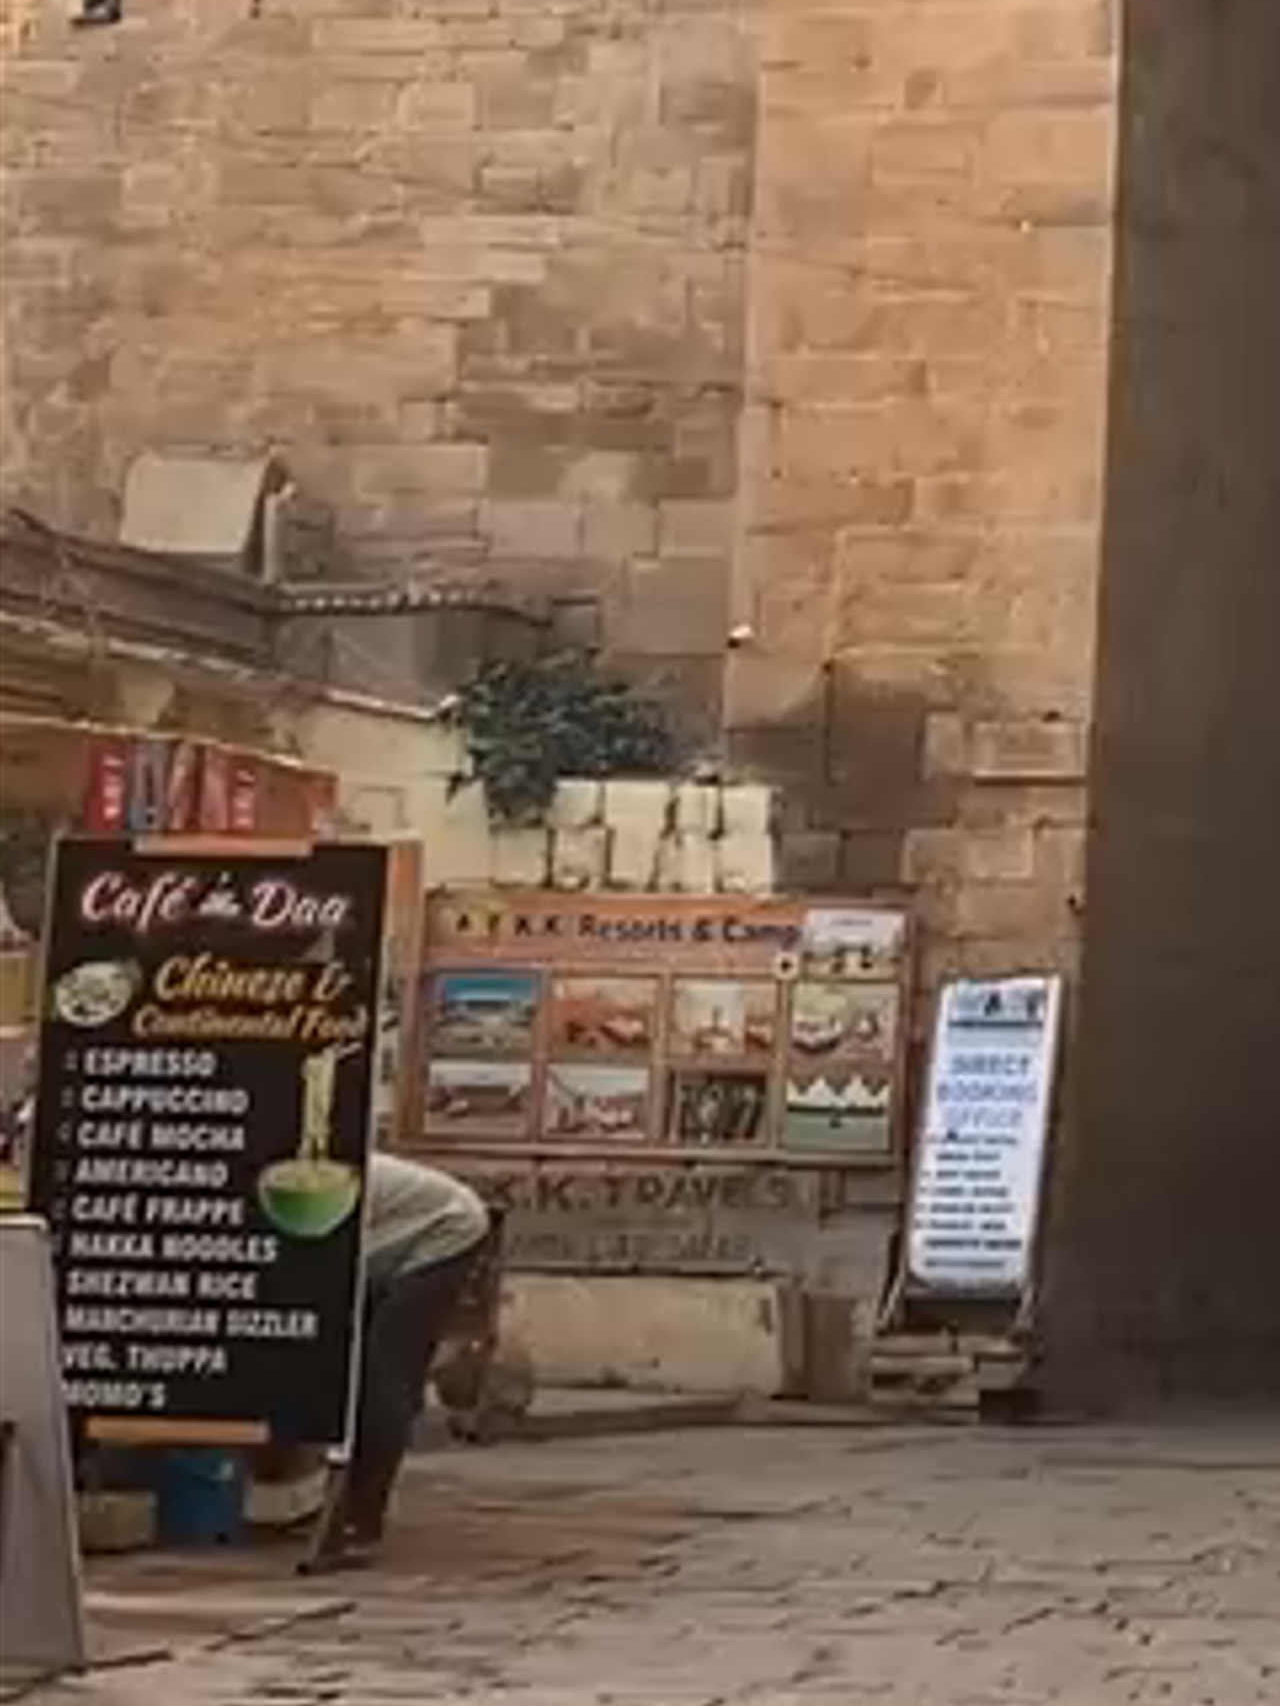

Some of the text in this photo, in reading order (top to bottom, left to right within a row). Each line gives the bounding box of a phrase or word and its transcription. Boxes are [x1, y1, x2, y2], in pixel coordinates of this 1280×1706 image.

[81, 872, 196, 932] Café
[154, 950, 305, 1002] Chinese
[132, 1005, 368, 1041] Continental Food
[83, 1048, 217, 1077] ESPRESSO
[81, 1084, 249, 1116] CAPPUCCINO
[151, 1122, 246, 1151] MOCHA
[74, 1158, 230, 1188] AMERICANO
[71, 1233, 279, 1262] HAKKA NOODLES
[197, 1271, 259, 1300] RICE
[66, 1304, 319, 1338] MANCHURIAN SIZZLER
